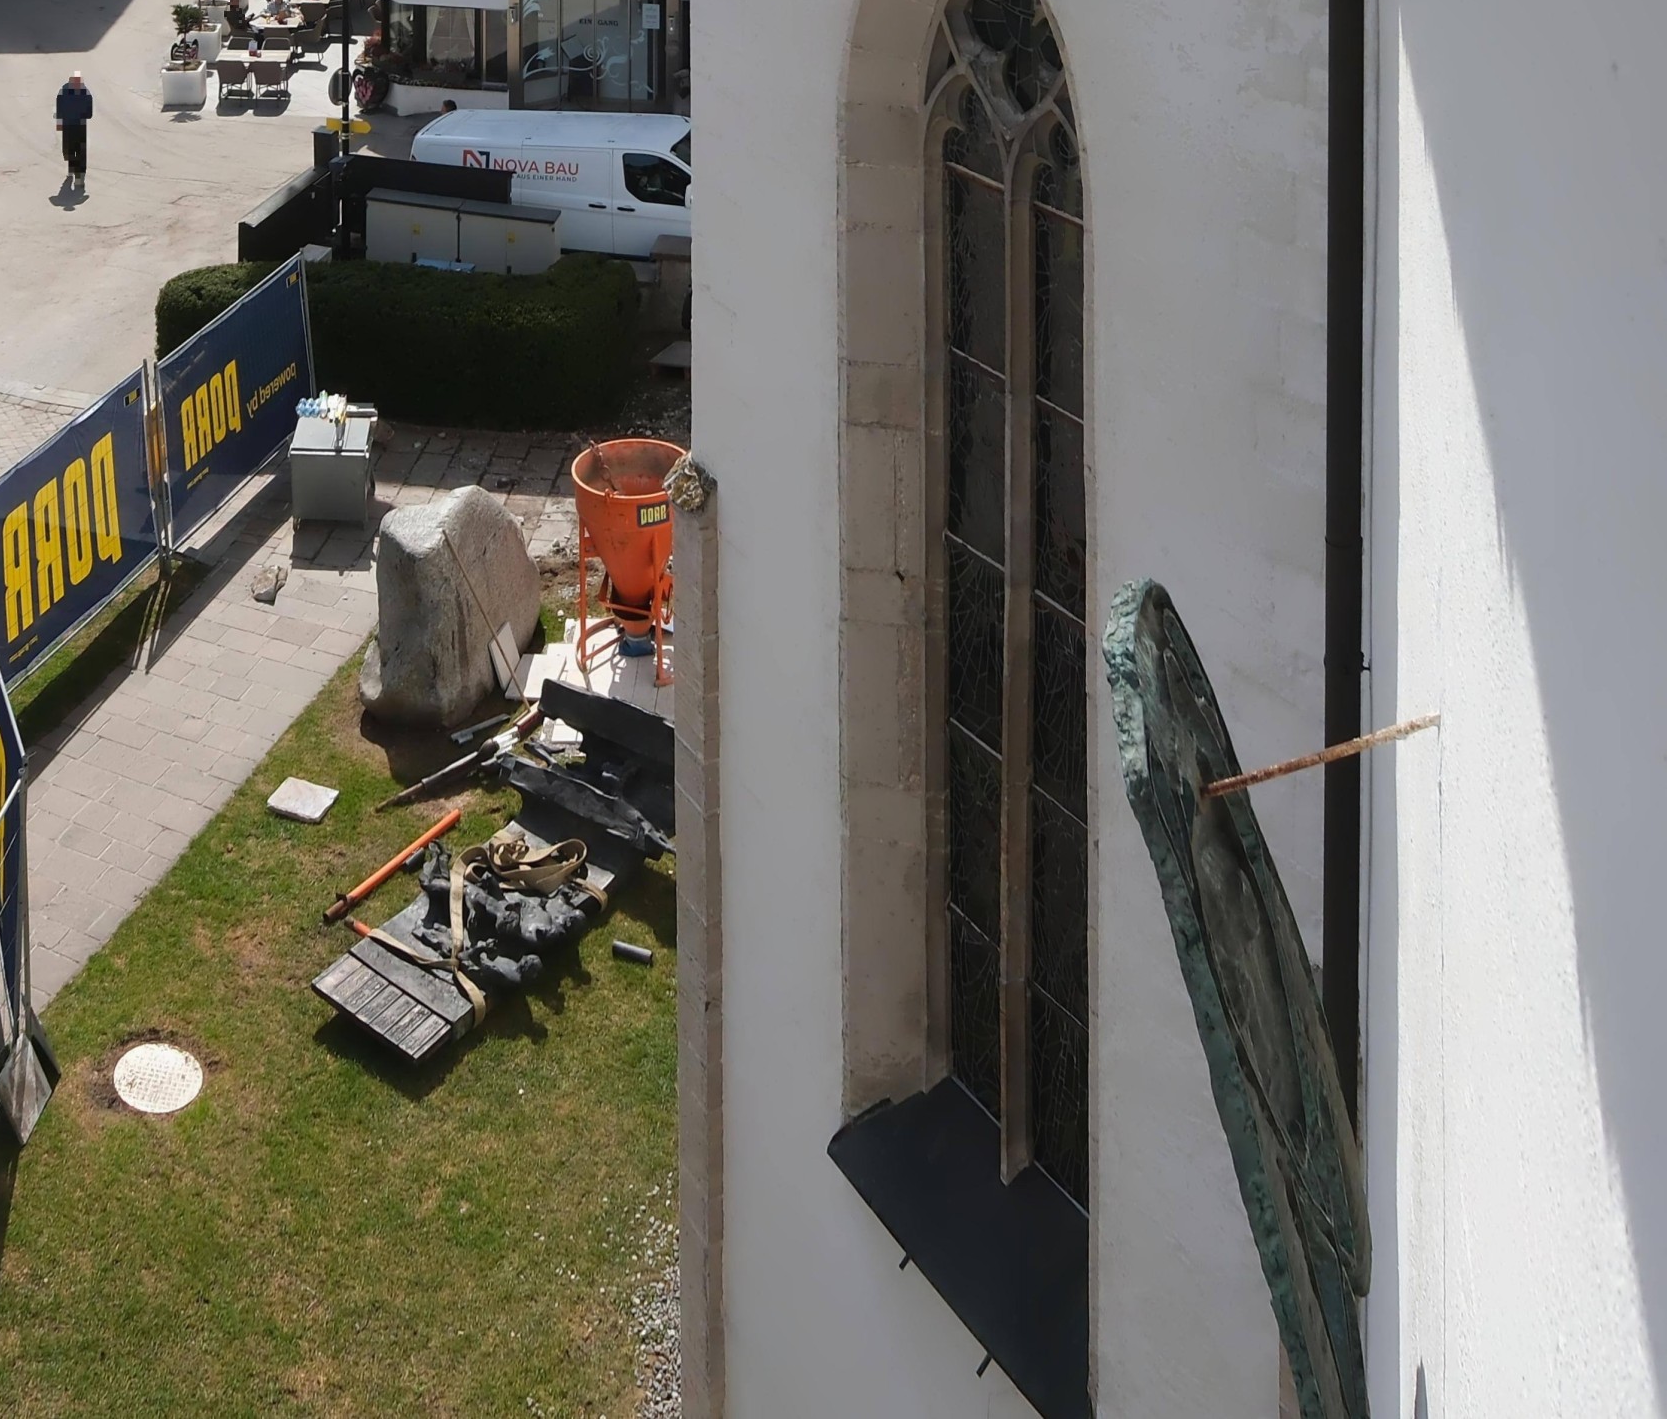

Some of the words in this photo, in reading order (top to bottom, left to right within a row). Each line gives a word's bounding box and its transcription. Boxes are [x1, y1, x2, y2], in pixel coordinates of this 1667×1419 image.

[578, 18, 593, 26] EIN
[493, 158, 539, 175] NOVA
[545, 160, 579, 175] BAU
